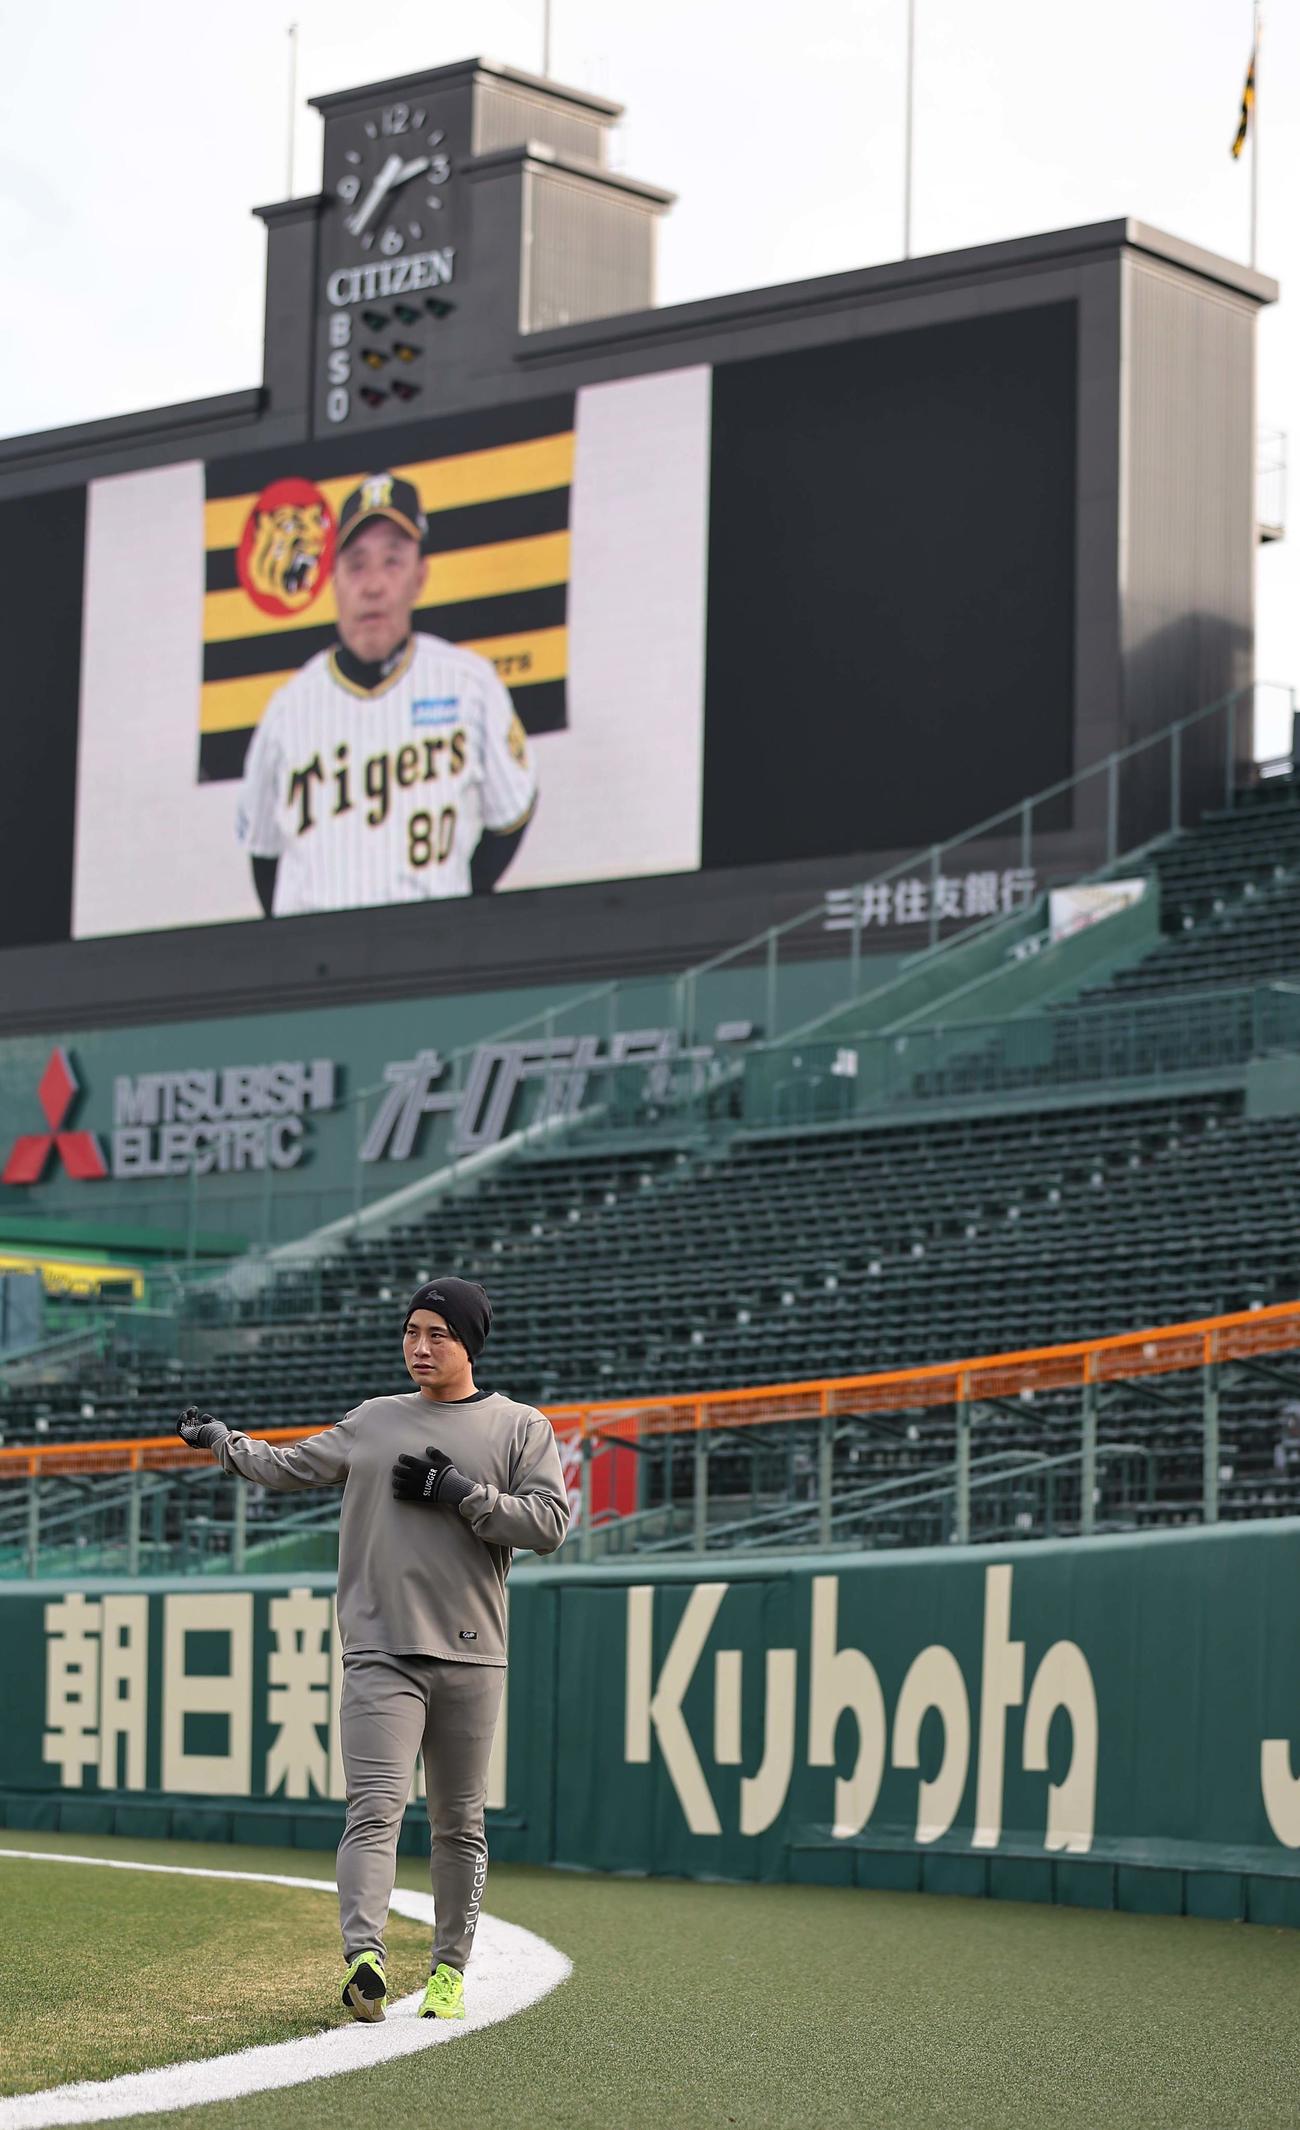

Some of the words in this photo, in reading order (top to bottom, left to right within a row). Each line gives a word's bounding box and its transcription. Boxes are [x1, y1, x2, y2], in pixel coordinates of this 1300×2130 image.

[382, 102, 410, 136] 12
[336, 175, 361, 205] 9
[427, 153, 450, 185] 3
[380, 224, 404, 256] 6
[327, 246, 455, 306] CITIZEN
[329, 312, 350, 348] B
[328, 350, 350, 385] S
[327, 386, 349, 422] O
[287, 728, 466, 837] Tigers
[408, 805, 457, 869] 80
[114, 1058, 335, 1127] MITSUBISHI
[113, 1116, 303, 1179] ELECTRIC
[423, 1468, 438, 1497] SLUGGER
[43, 1588, 507, 1810] 朝日新
[625, 1564, 1099, 1853] Kubota
[464, 1852, 487, 1935] SLUGGER
